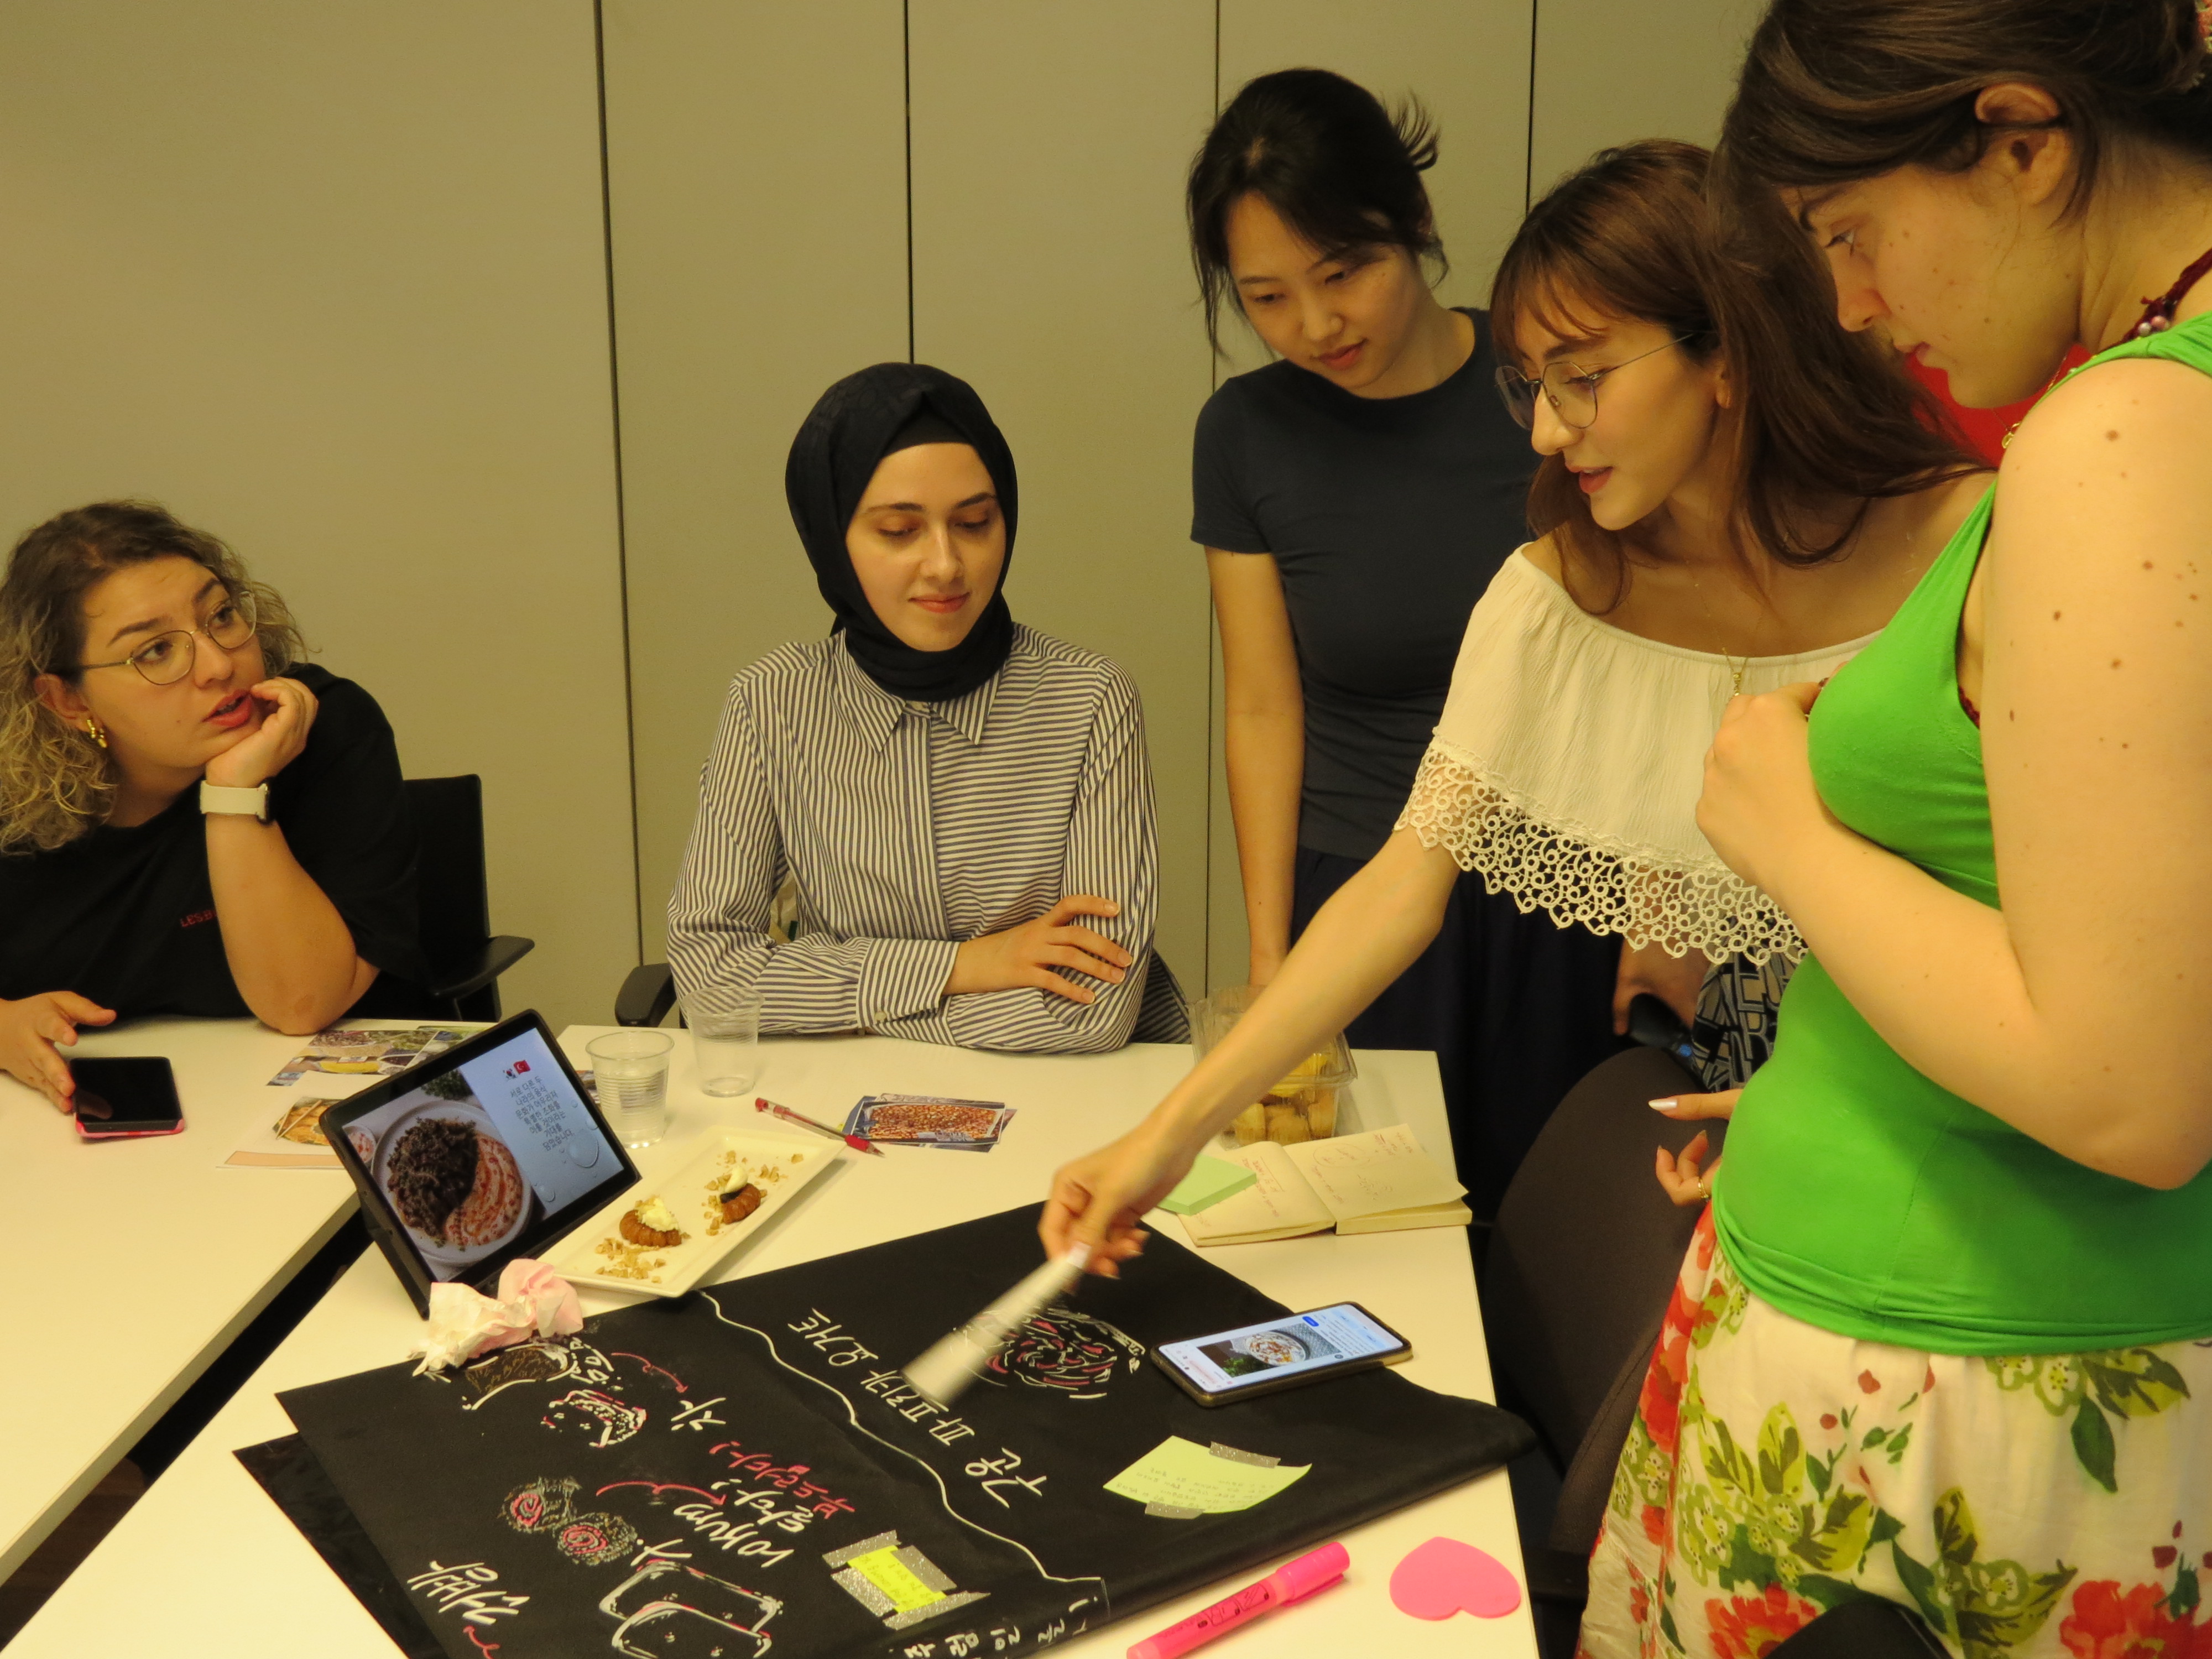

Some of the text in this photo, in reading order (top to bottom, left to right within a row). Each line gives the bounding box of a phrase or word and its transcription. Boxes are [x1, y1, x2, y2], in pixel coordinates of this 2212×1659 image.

[787, 1308, 1047, 1509] 구운 파프리카 요거트
[708, 1441, 855, 1520] 부드럽다!
[711, 1478, 814, 1533] 달다!
